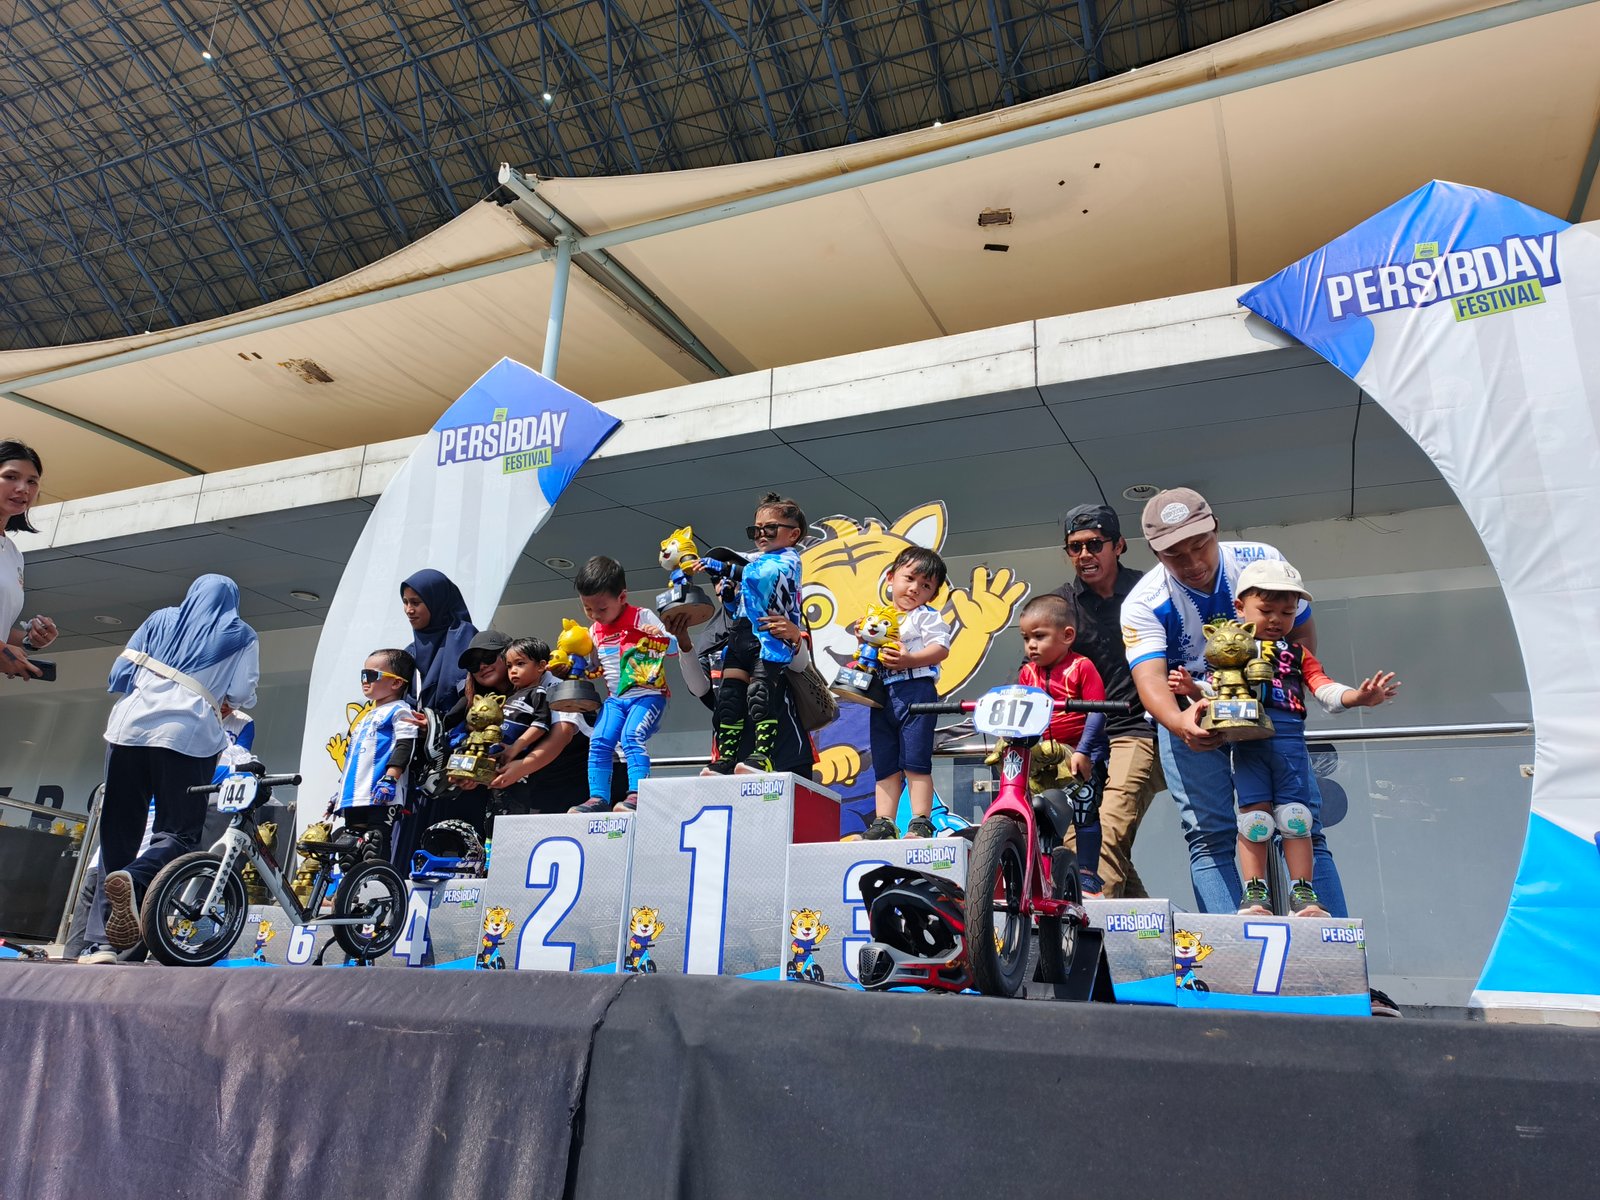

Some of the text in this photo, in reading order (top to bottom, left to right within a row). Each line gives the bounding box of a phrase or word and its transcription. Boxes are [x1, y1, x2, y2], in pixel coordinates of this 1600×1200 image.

[1327, 235, 1554, 318] PERSIBDAY
[1458, 284, 1540, 318] FESTIVAL
[440, 411, 567, 462] PERSIBDAY
[505, 450, 549, 471] FESTIVAL
[989, 699, 1034, 728] 817
[223, 784, 246, 804] 144
[741, 780, 784, 796] PERSIBDAY
[588, 818, 628, 833] PERSIBDAY
[906, 846, 956, 864] PERSIBDAY
[443, 889, 480, 902] PERSIBDAY
[515, 836, 585, 972] 2
[680, 805, 733, 974] 1
[393, 888, 433, 967] 4
[1106, 914, 1165, 931] PERSIBDAY
[1321, 928, 1365, 942] PERSIB
[287, 925, 317, 965] 6
[1244, 922, 1292, 995] 7
